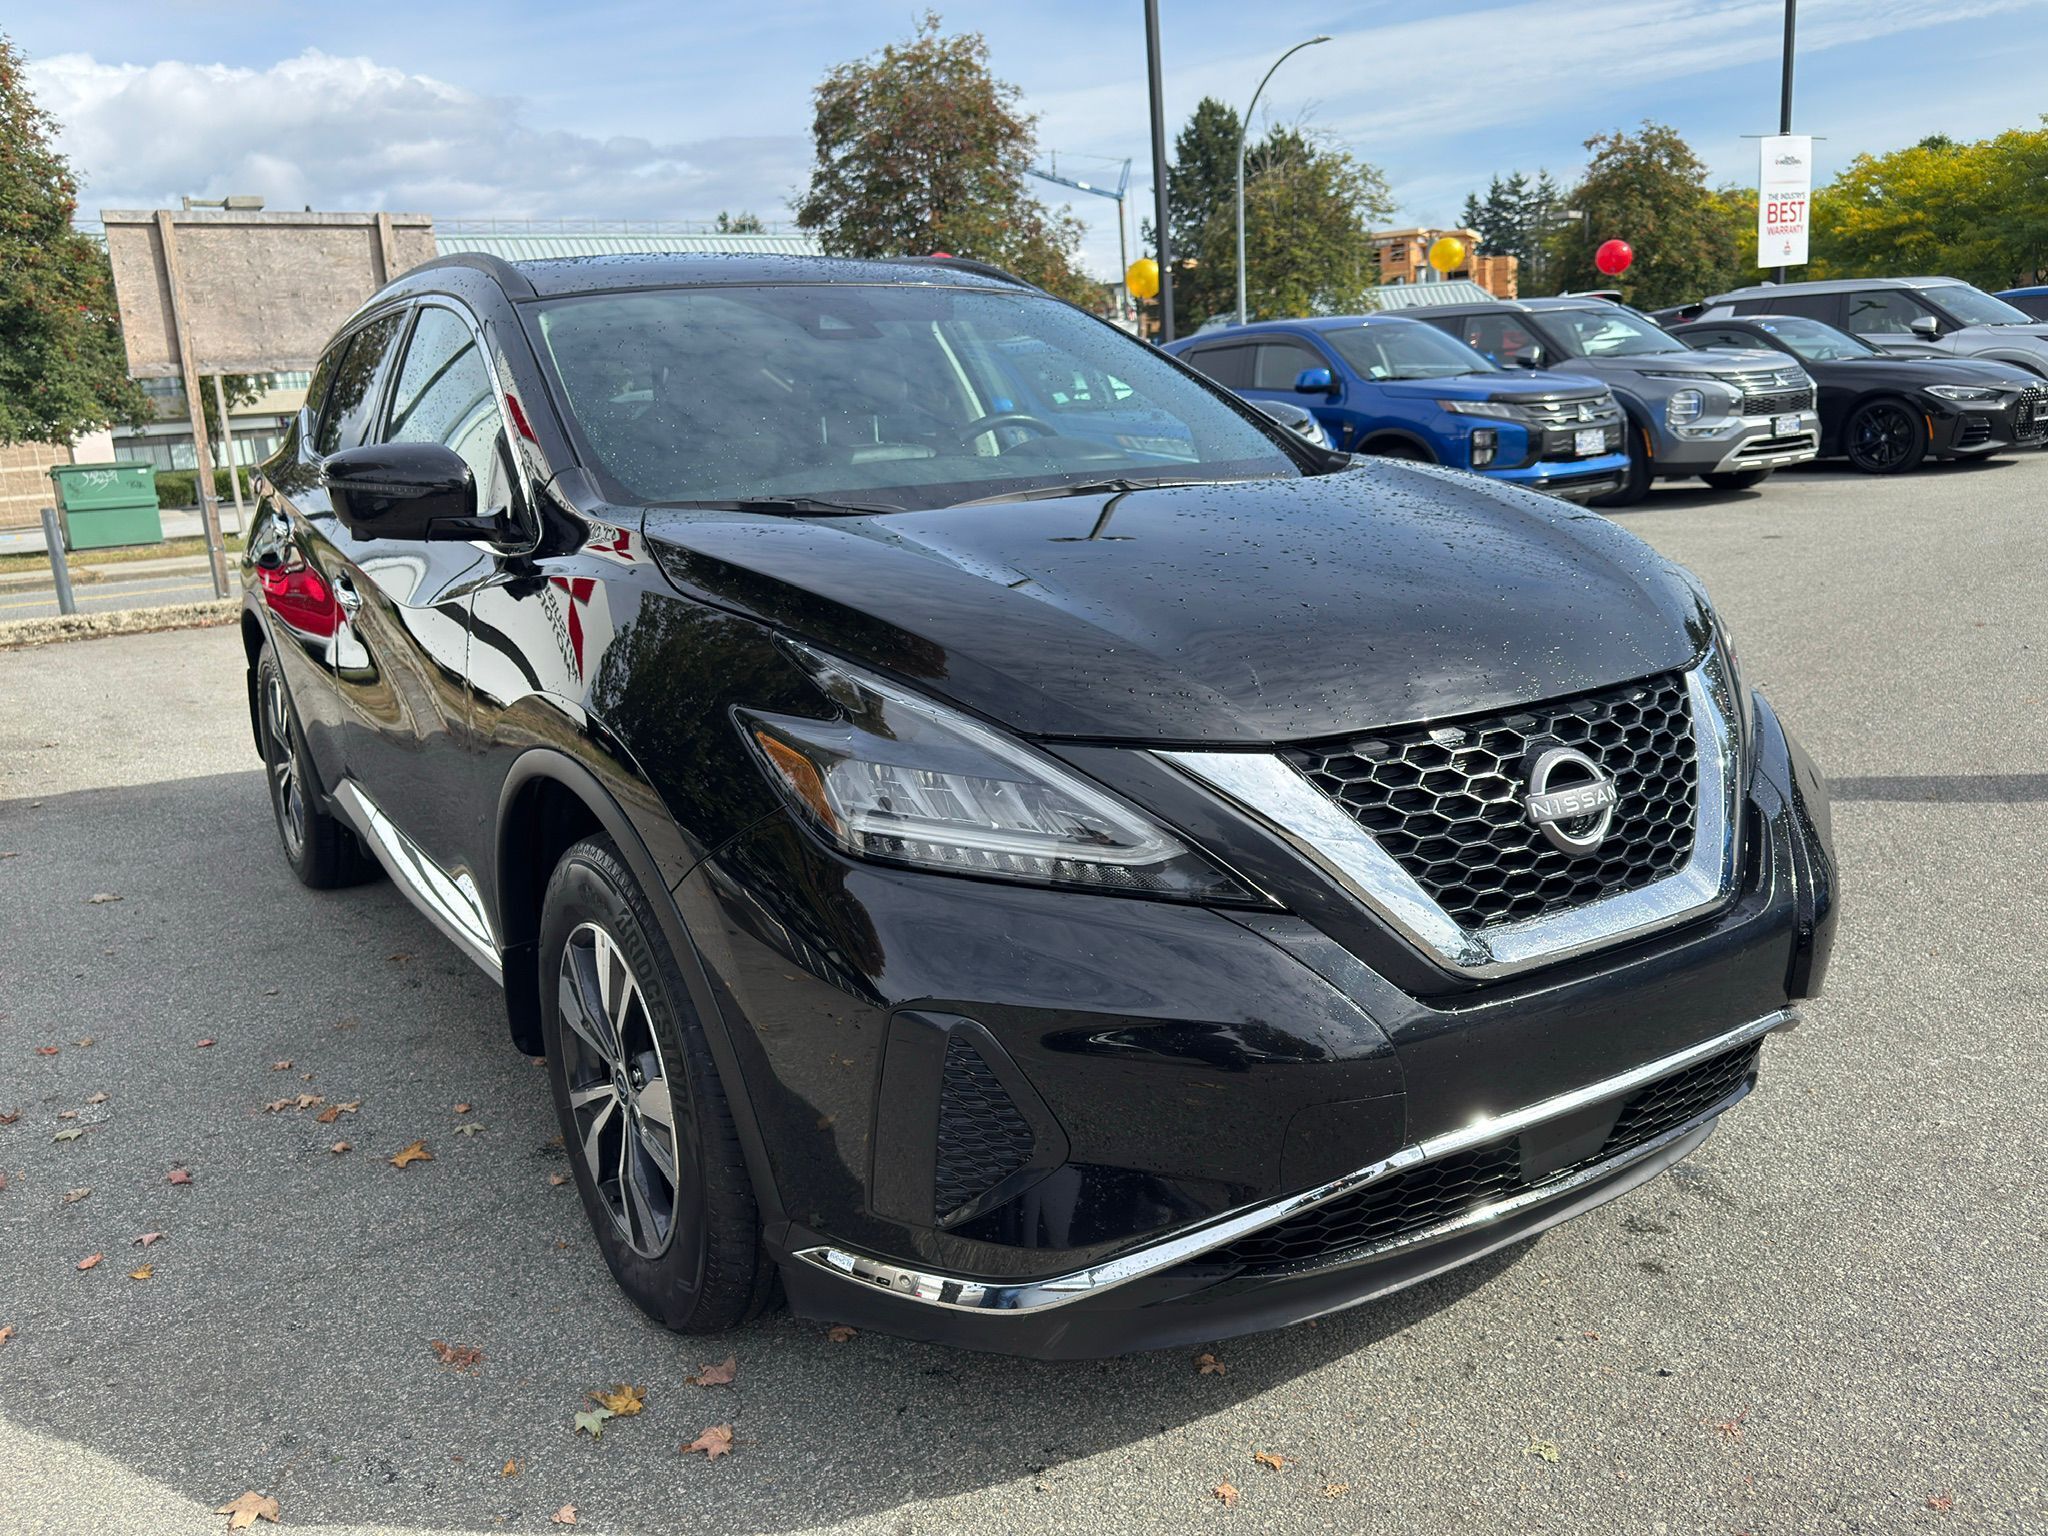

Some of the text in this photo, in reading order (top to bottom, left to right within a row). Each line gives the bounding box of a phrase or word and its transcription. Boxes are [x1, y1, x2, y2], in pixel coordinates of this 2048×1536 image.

[1768, 192, 1779, 200] THE
[1767, 201, 1805, 224] BEST
[1766, 225, 1804, 236] WARRANTY
[1530, 784, 1617, 818] NISSAN
